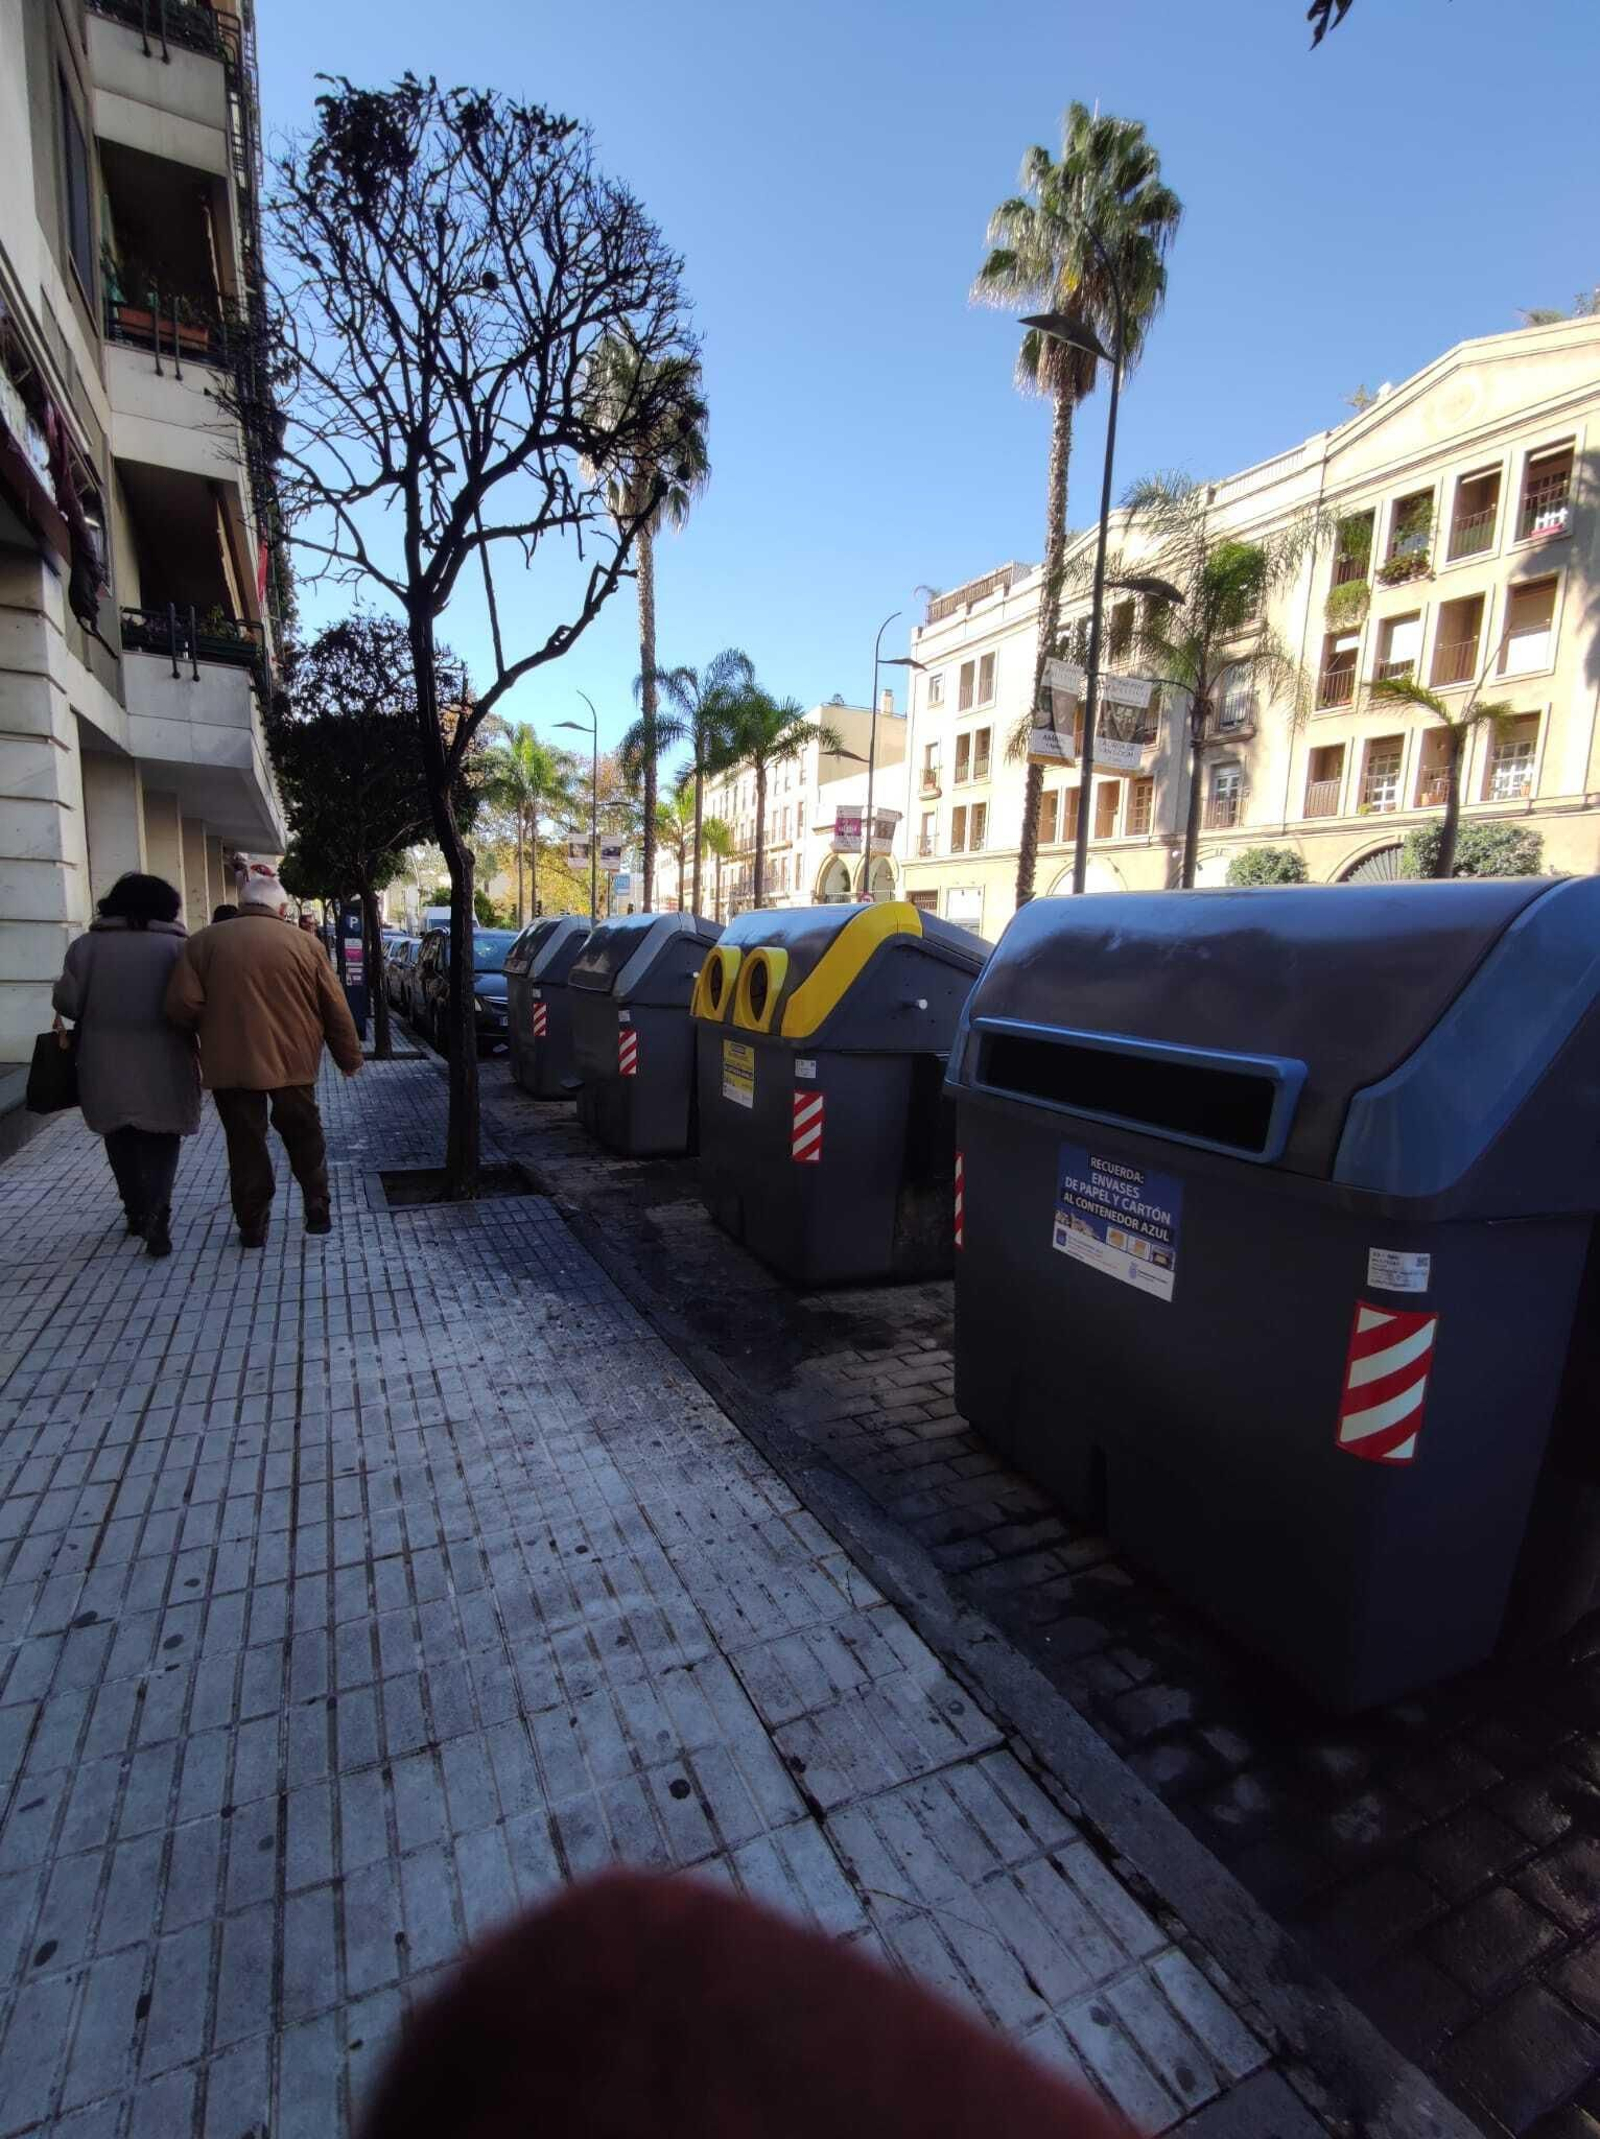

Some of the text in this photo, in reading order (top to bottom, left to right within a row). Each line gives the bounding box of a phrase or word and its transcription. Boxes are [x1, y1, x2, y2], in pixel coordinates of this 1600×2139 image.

[350, 916, 358, 929] P
[1090, 1157, 1144, 1183] RECUERDA:
[1091, 1172, 1141, 1199] ENVASES
[1065, 1176, 1170, 1224] DE PAPEL Y CARTÓN
[1063, 1192, 1170, 1242] AL CONTENEDOR AZUL
